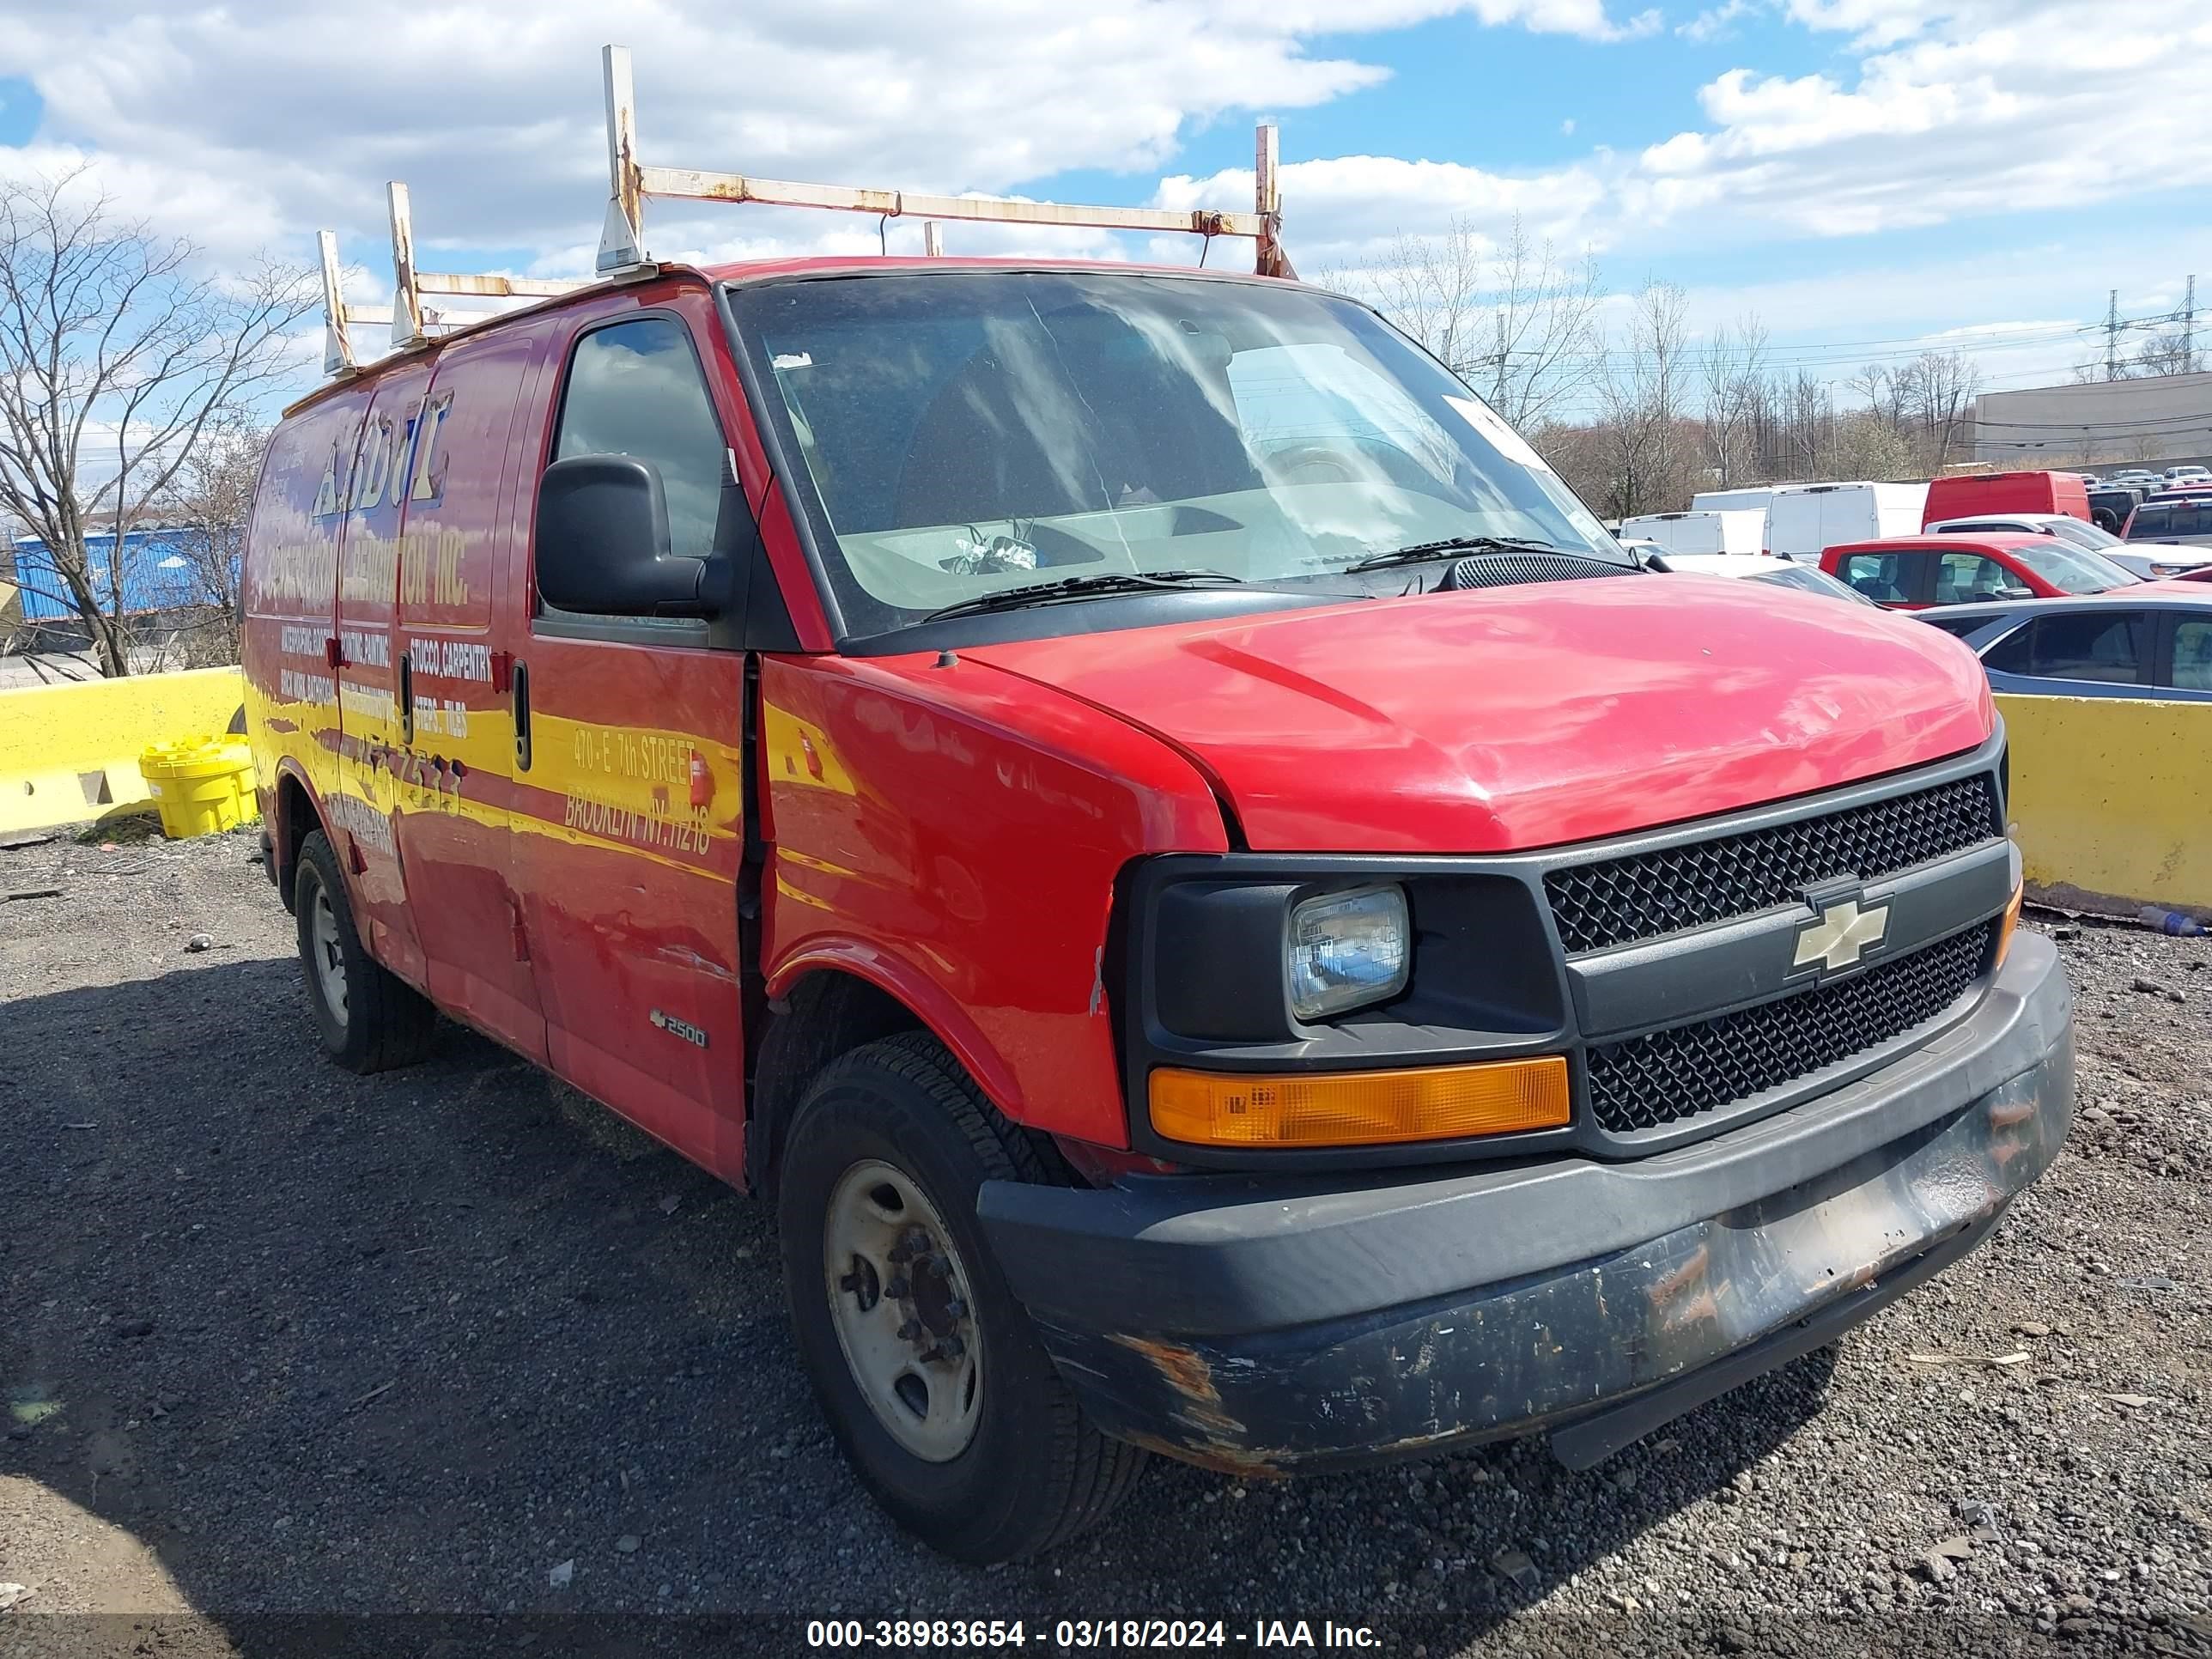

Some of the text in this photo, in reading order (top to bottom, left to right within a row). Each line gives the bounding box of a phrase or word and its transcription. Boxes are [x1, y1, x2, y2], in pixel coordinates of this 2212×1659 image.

[618, 733, 638, 777] 7th
[641, 734, 695, 787] STREET
[564, 786, 638, 840] BROOKLYN
[667, 1017, 706, 1048] 2500
